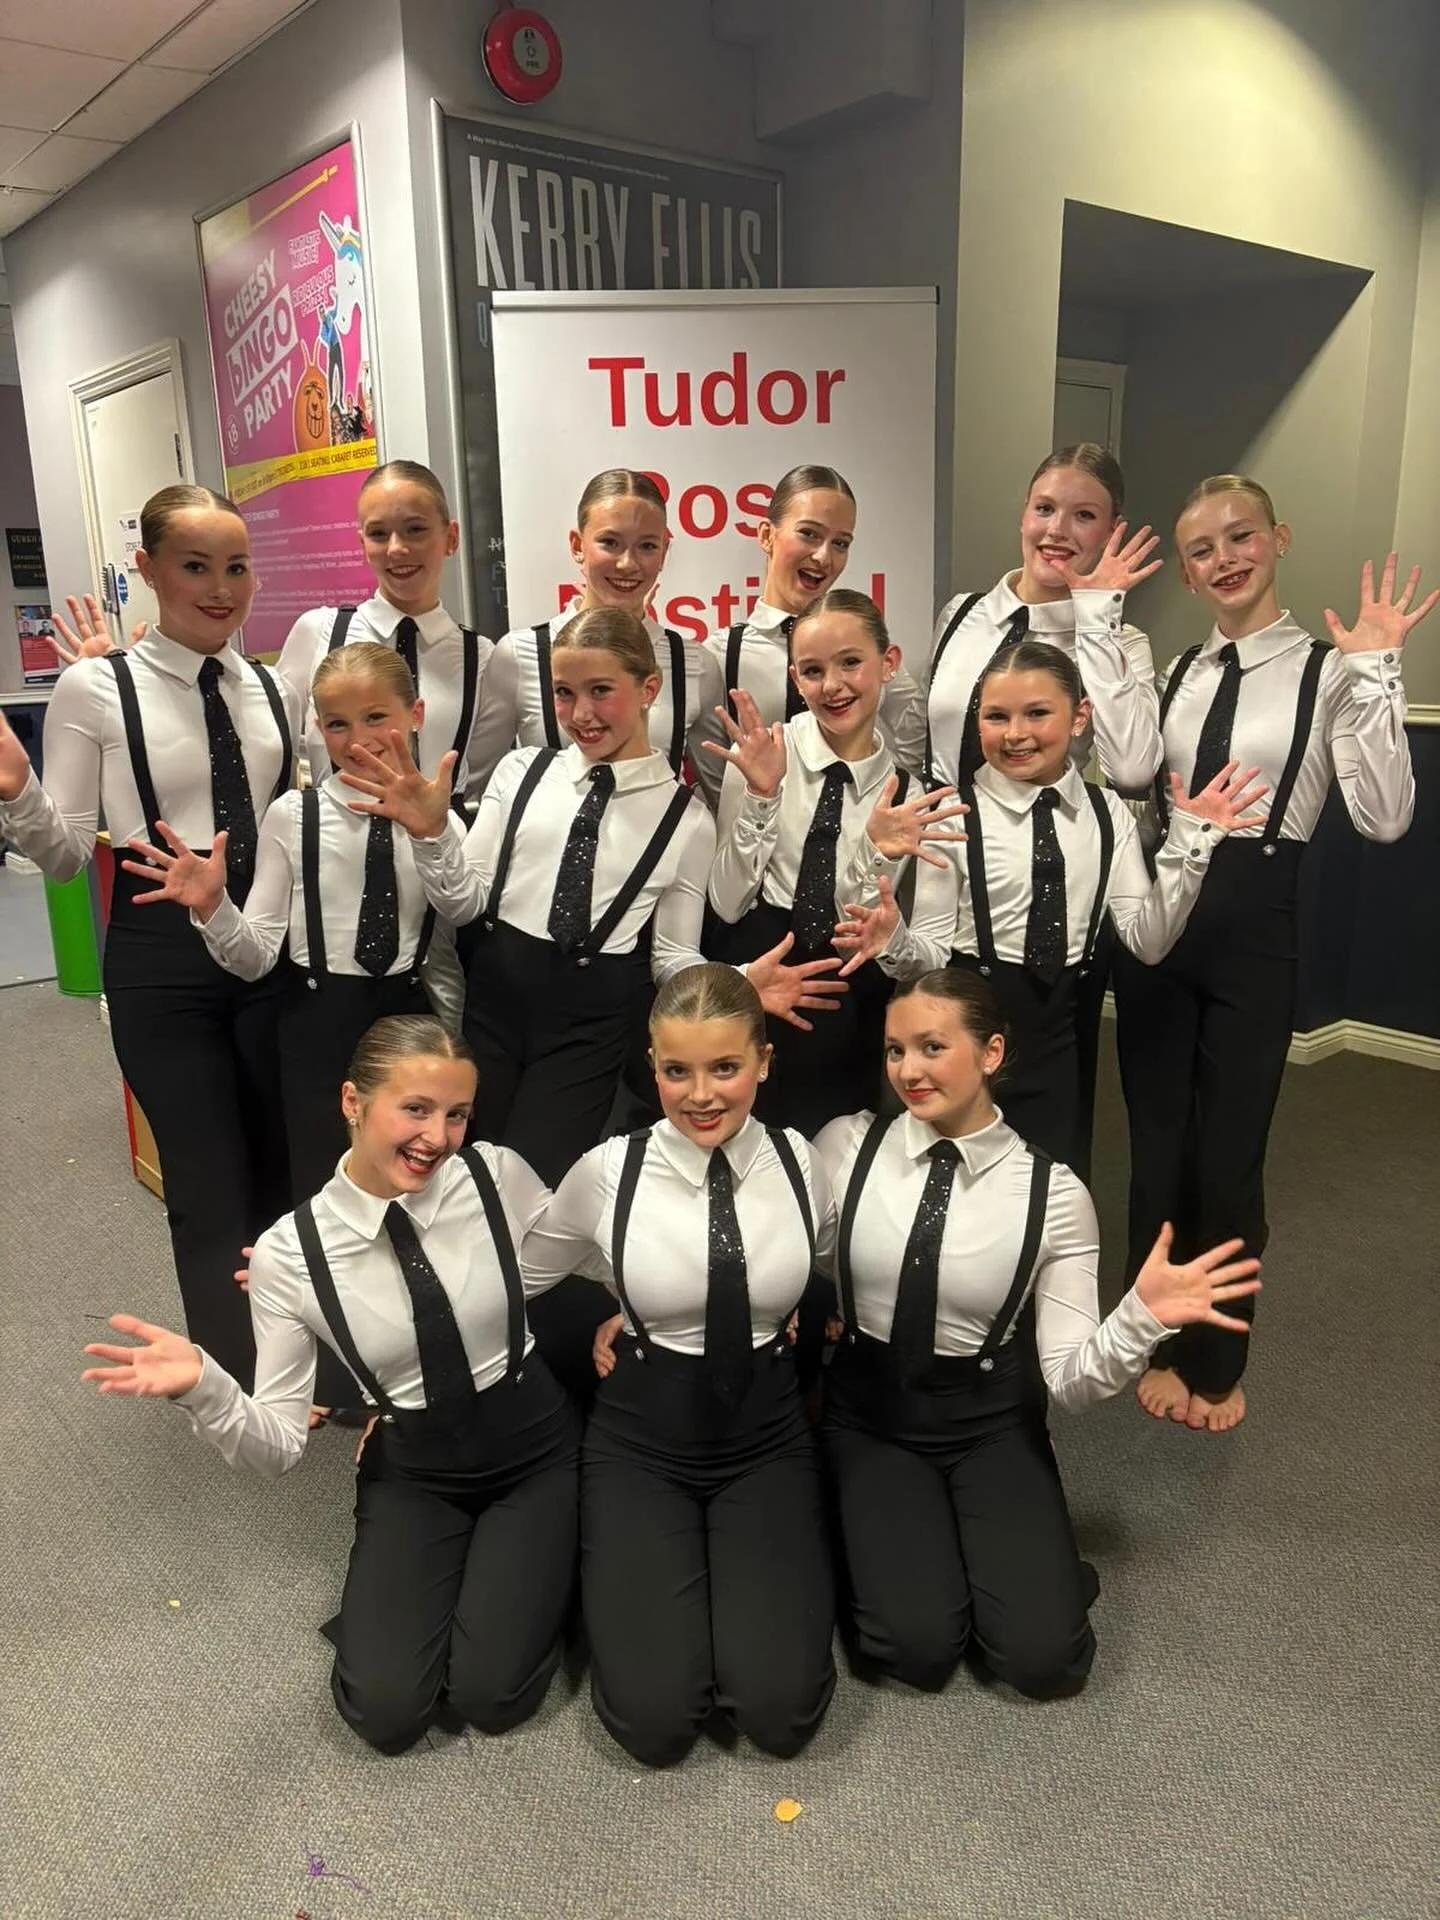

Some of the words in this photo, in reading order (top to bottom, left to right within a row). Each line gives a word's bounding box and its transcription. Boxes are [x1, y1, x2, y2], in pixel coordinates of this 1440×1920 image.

[469, 155, 628, 290] KERRY
[652, 191, 761, 290] ELLIS
[224, 248, 277, 340] CHEESY
[228, 296, 294, 402] BINGO
[588, 351, 846, 427] Tudor
[243, 359, 292, 439] PARTY
